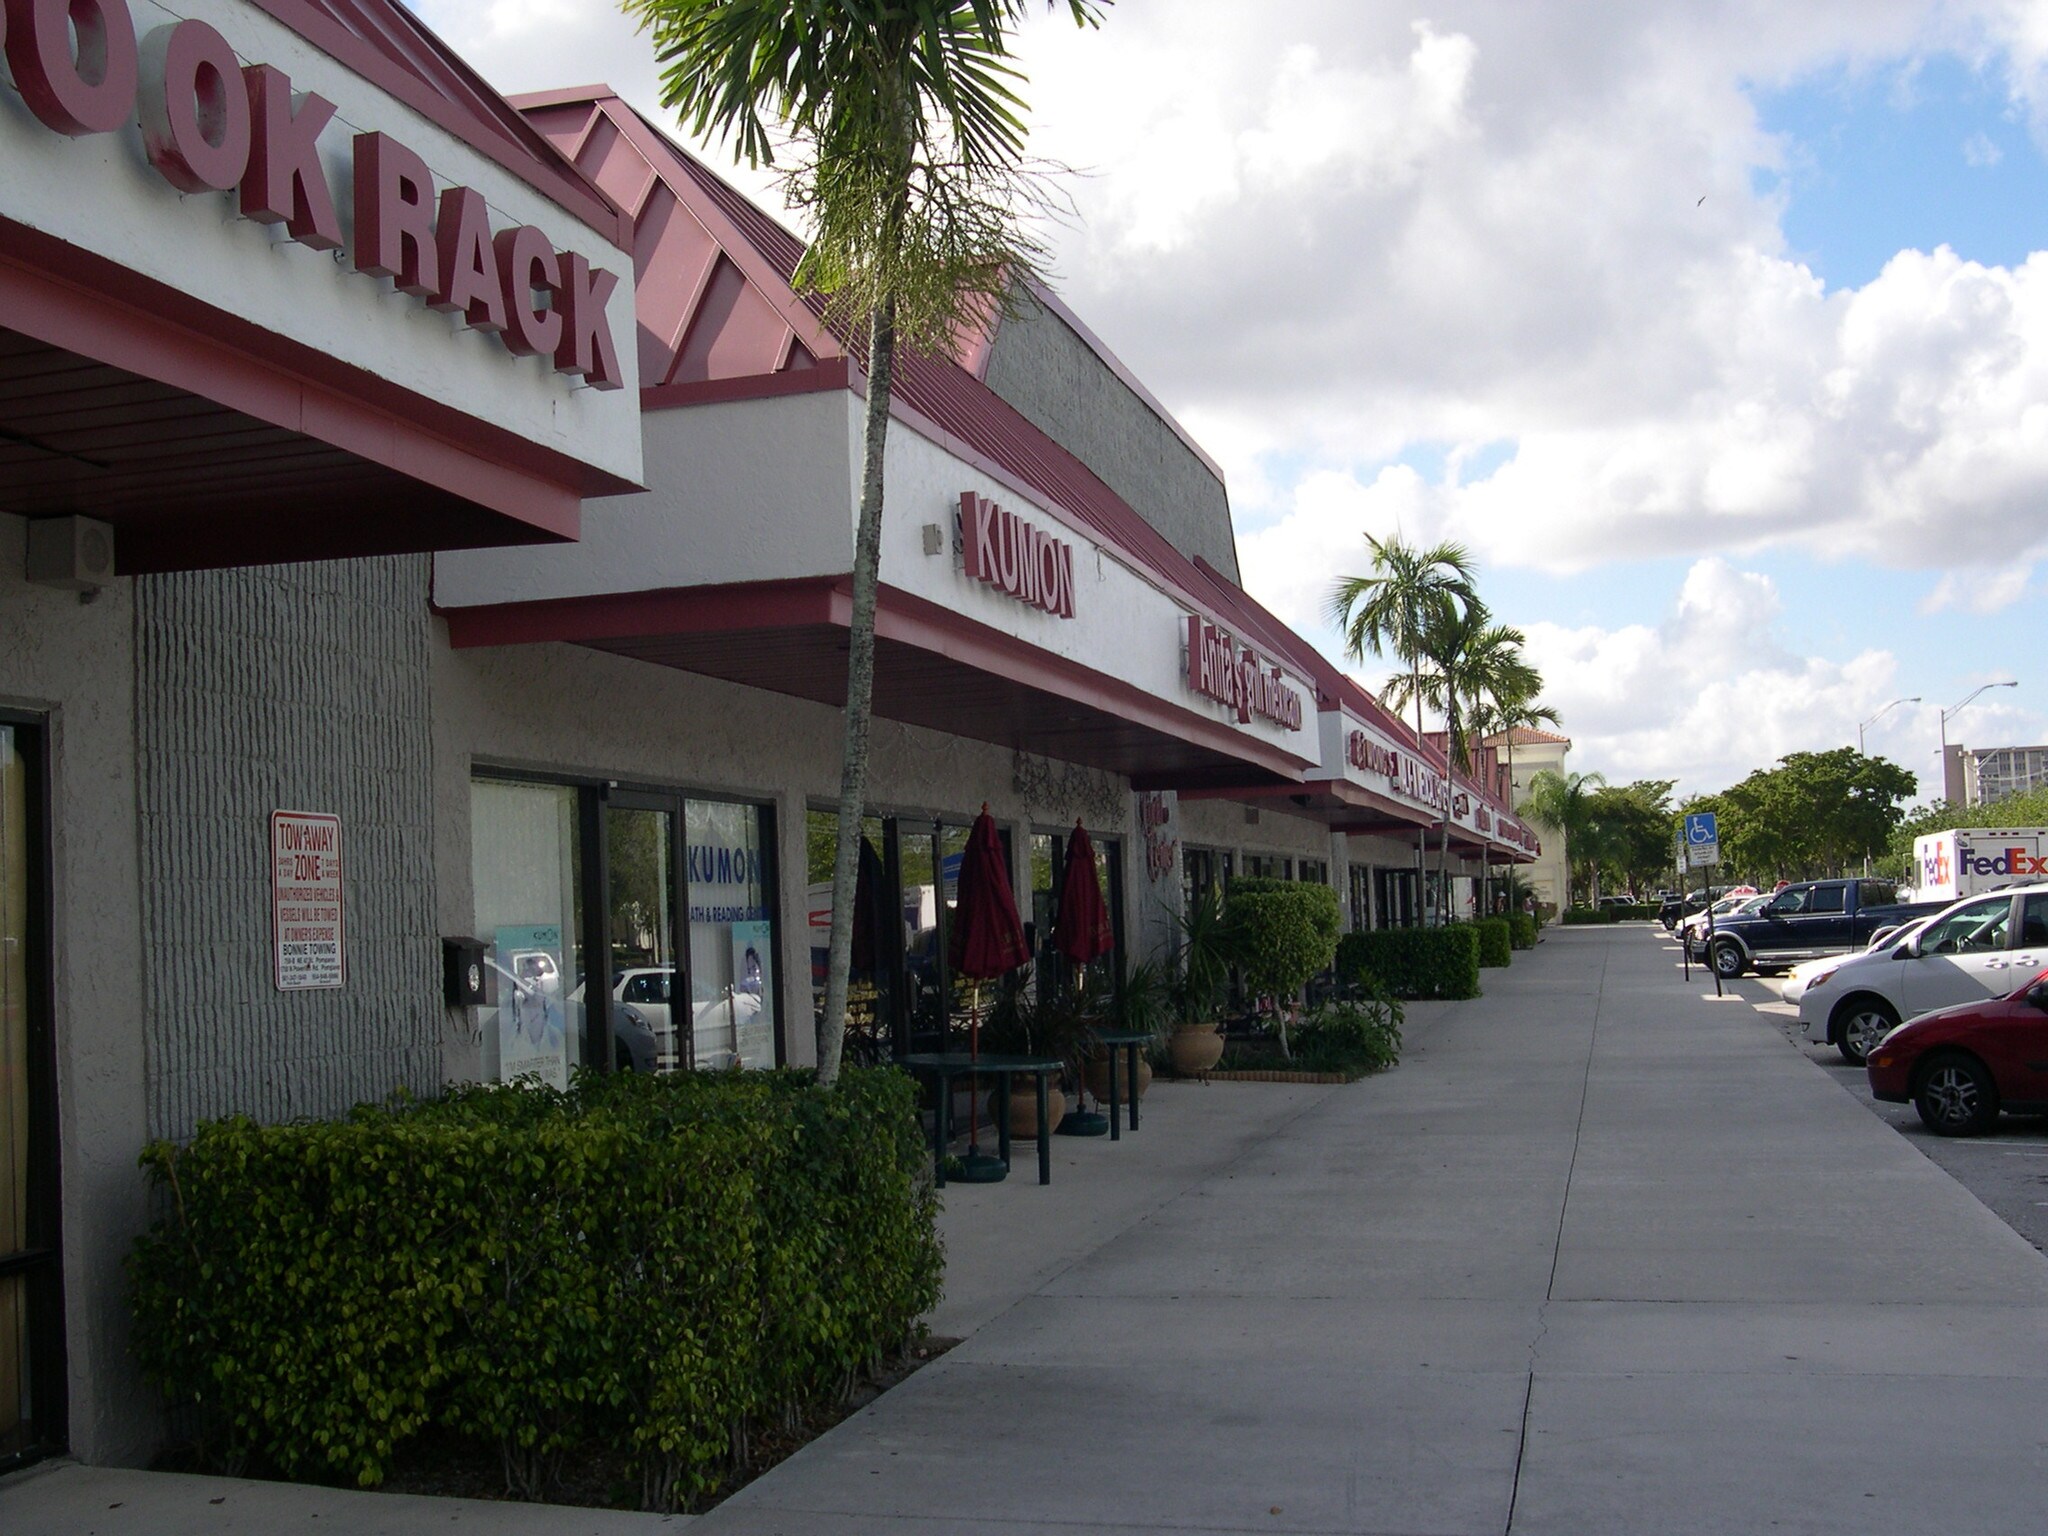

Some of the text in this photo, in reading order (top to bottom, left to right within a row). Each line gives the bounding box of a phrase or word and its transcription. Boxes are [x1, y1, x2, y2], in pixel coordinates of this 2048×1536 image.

[0, 0, 624, 391] OOK RACK
[961, 491, 1076, 619] KUMON
[279, 823, 334, 851] TOW AWAY
[294, 854, 321, 881] ZONE
[688, 845, 762, 884] KUMON
[1924, 842, 1950, 886] FedEx
[1960, 848, 2048, 875] FedEx
[278, 888, 312, 901] UNAUTHORIZED
[314, 888, 335, 901] VEHICLES
[302, 908, 312, 921] WILL
[314, 908, 320, 921] BE
[321, 908, 338, 921] TOWED
[690, 907, 704, 922] ATH
[713, 907, 744, 922] READING
[313, 928, 334, 941] EXPENSE
[283, 943, 336, 955] BONNIE TOWING
